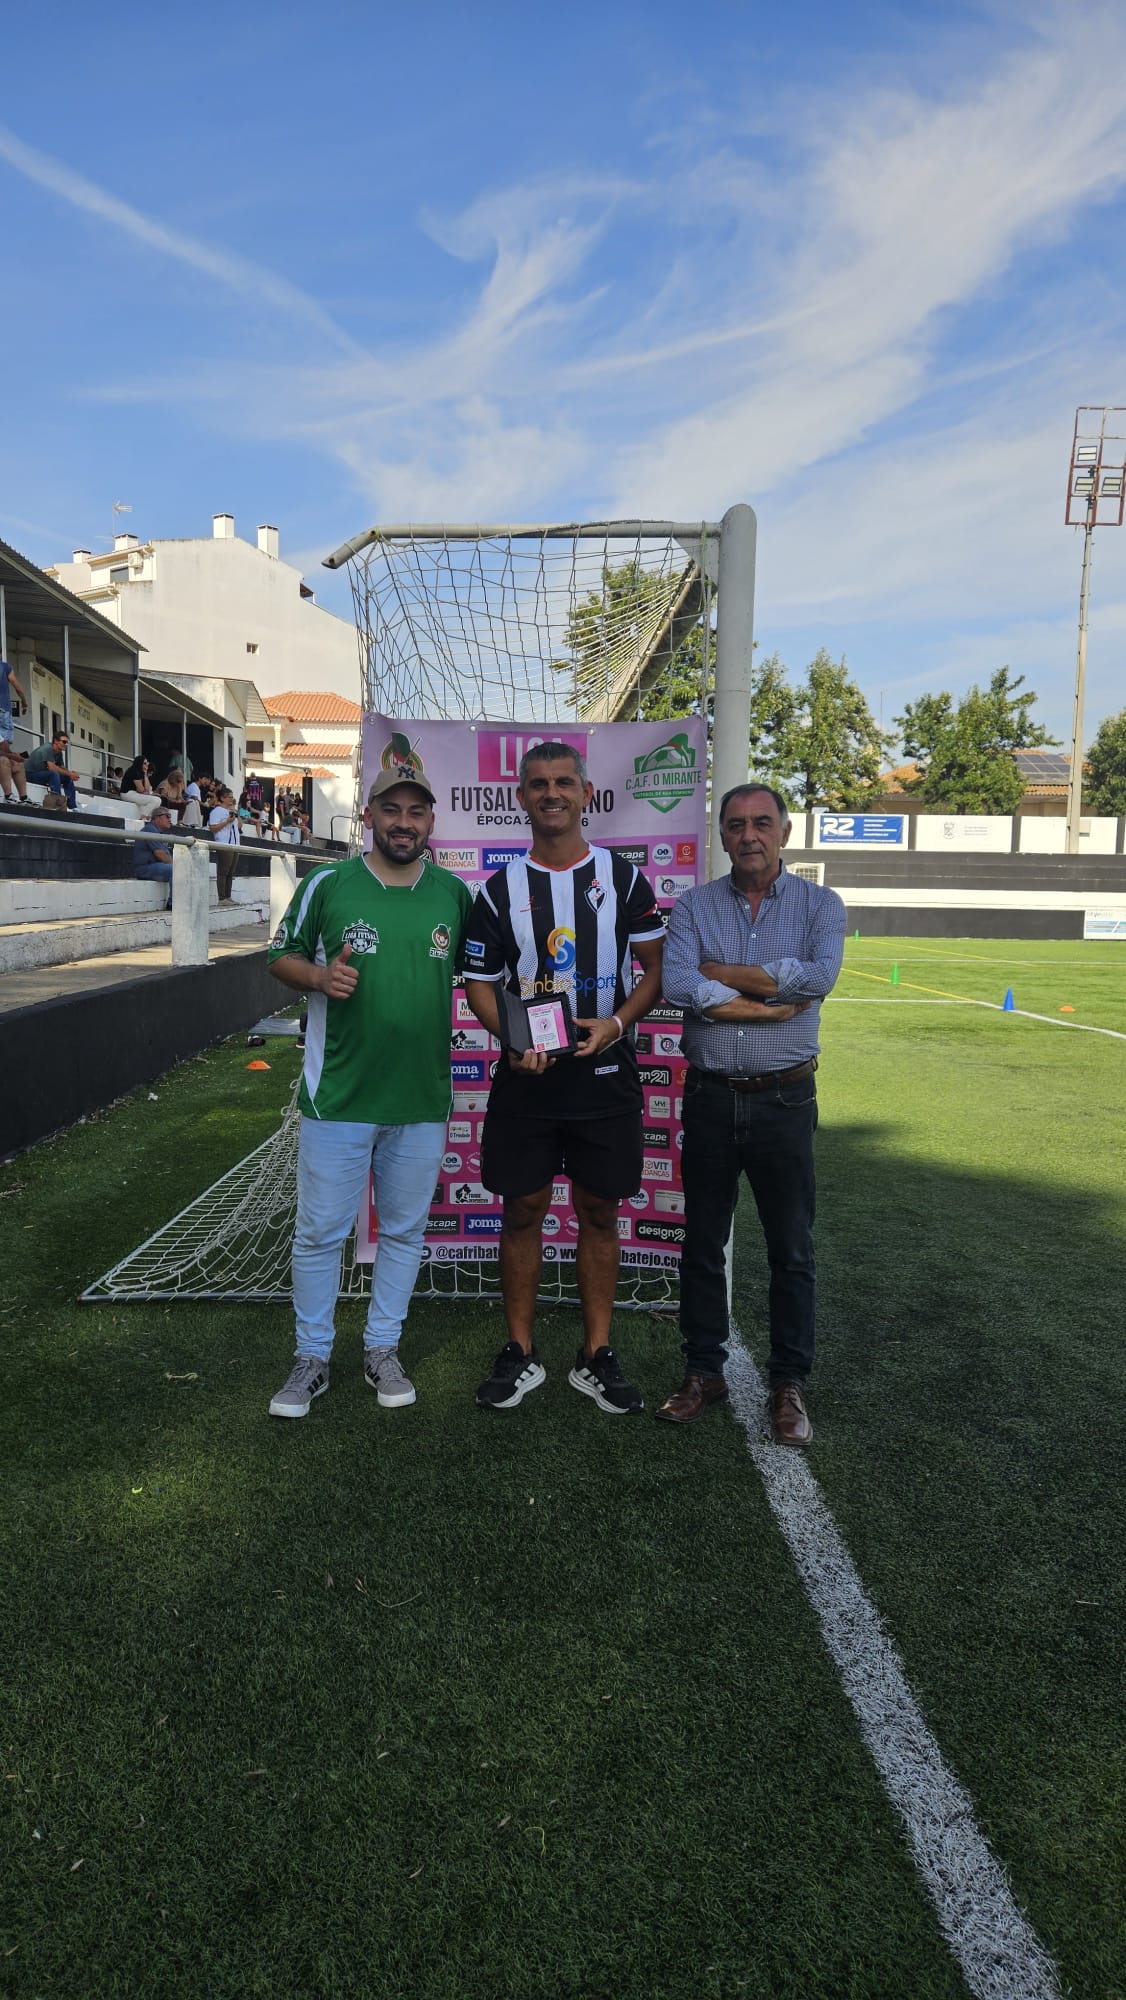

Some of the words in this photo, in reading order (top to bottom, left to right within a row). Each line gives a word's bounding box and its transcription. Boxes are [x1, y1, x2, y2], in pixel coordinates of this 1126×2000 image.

[625, 775, 651, 791] C.A.F.
[653, 773, 660, 786] O
[662, 770, 702, 786] MIRANTE
[451, 787, 517, 812] FUTSAL
[477, 814, 522, 826] ÉPOCA
[451, 1065, 479, 1075] oma
[638, 1225, 686, 1242] design2
[436, 1246, 501, 1260] @cafribat
